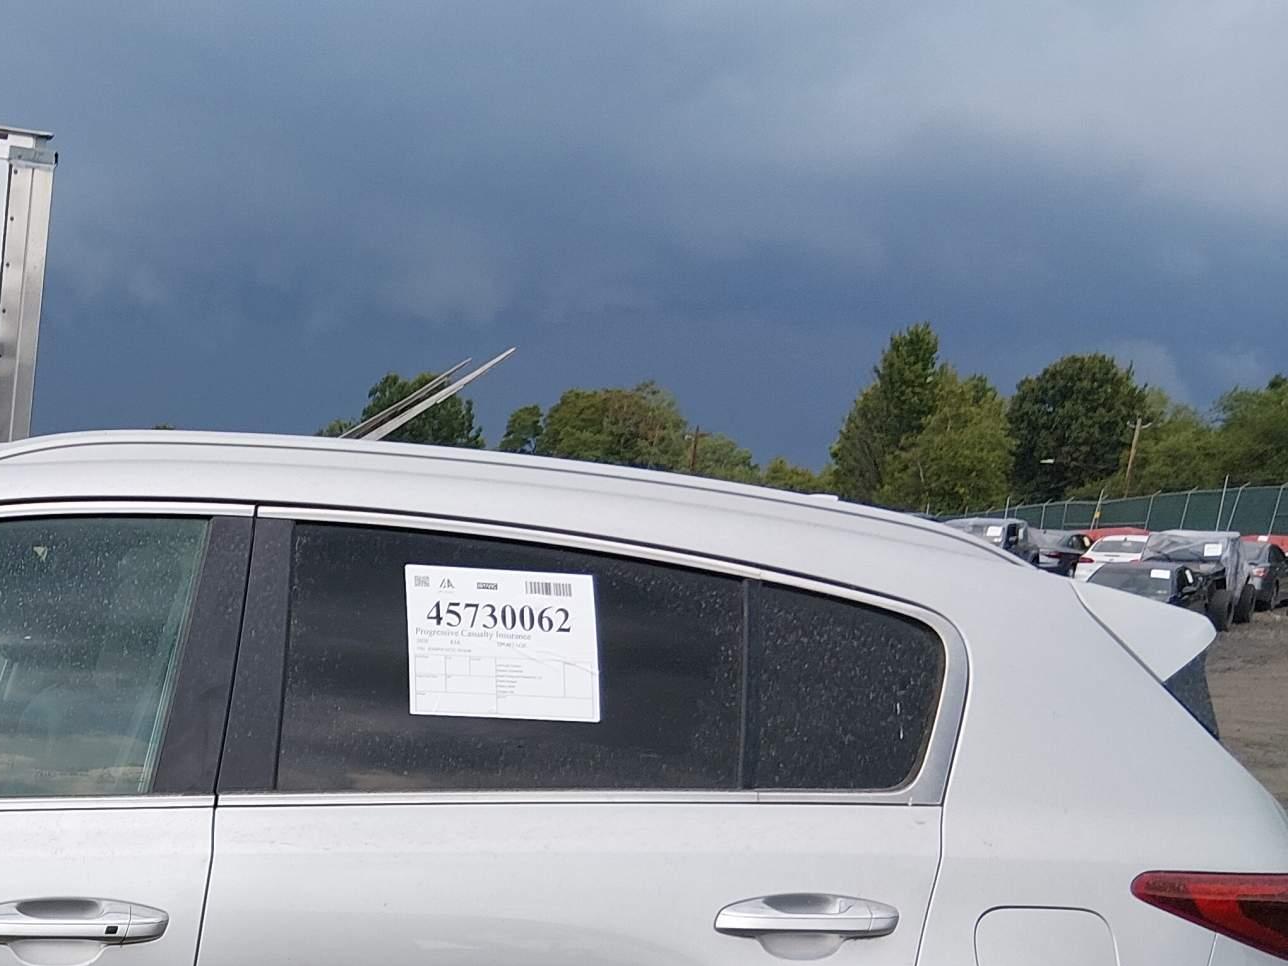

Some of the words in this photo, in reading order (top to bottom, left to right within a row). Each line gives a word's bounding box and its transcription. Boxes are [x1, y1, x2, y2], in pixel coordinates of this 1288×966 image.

[426, 600, 572, 633] 45730062
[415, 627, 459, 638] Progressive
[460, 630, 493, 640] Casualty
[495, 631, 532, 641] Insurance
